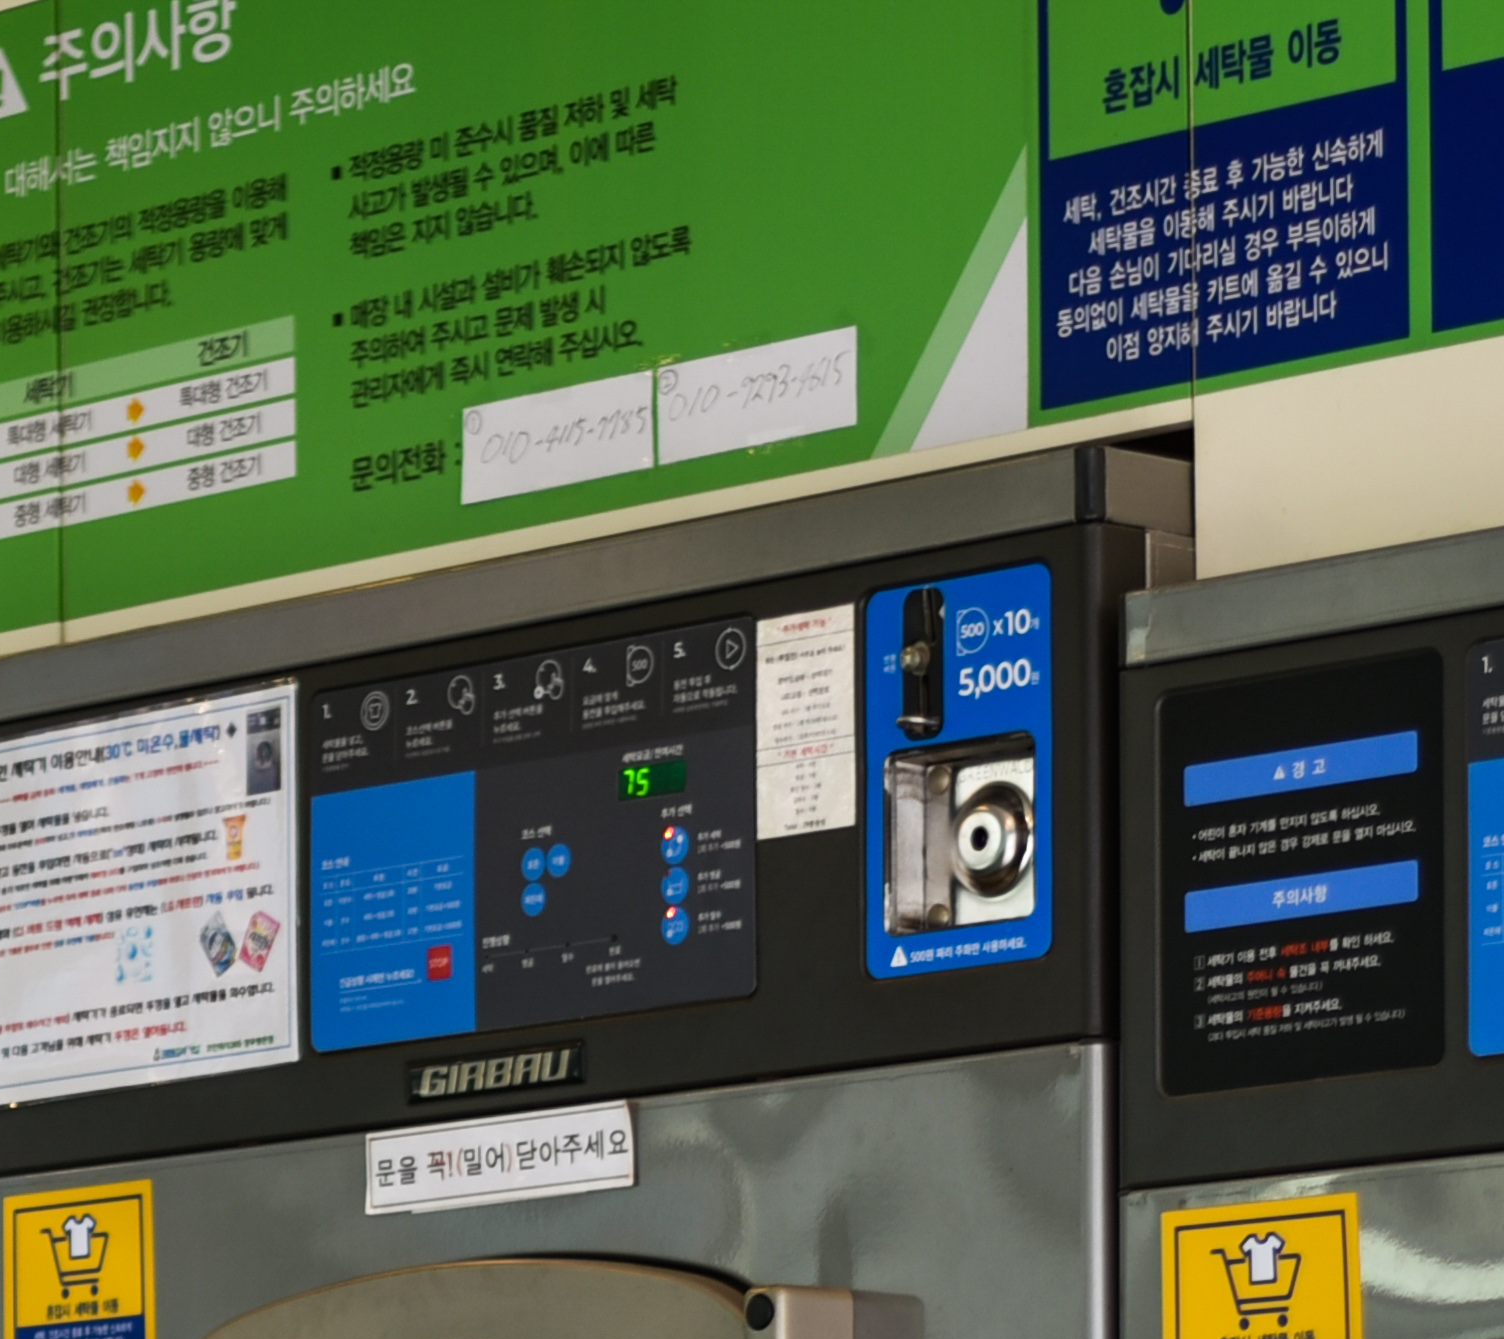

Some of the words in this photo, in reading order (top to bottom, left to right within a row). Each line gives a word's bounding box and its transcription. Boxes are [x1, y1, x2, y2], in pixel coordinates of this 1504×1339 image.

[39, 0, 237, 101] 주의사항
[1102, 49, 1182, 115] 혼잡시
[1193, 33, 1275, 90] 세탁물
[1287, 18, 1342, 69] 이동
[4, 147, 98, 198] 대해서는
[104, 116, 201, 172] 책임지지
[207, 95, 281, 148] 않으니
[288, 62, 417, 126] 주의하세요
[1063, 192, 1102, 225] 세탁,
[1109, 174, 1177, 217] 건조시간
[1183, 165, 1220, 202] 종료
[1225, 158, 1245, 190] 후
[1251, 145, 1305, 183] 가능한
[1311, 127, 1384, 172] 신속하게
[1088, 216, 1156, 256] 세탁물을
[1163, 202, 1215, 240] 이동해
[1221, 190, 1275, 228] 주시기
[1282, 173, 1354, 214] 바랍니다
[1056, 297, 1124, 338] 동의없이
[1130, 278, 1200, 321] 세탁물을
[1207, 268, 1259, 305] 카트에
[1265, 259, 1302, 295] 옮길
[1308, 255, 1328, 285] 수
[1335, 243, 1389, 280] 있으니
[1068, 265, 1103, 296] 다음
[1108, 252, 1160, 290] 손님이
[1167, 235, 1236, 276] 기다리실
[1244, 227, 1280, 262] 경우
[1286, 205, 1376, 252] 부득이하게
[1106, 330, 1140, 363] 이점
[1146, 314, 1200, 356] 양지해
[1205, 305, 1258, 343] 주시기
[1265, 290, 1338, 330] 바랍니다
[350, 439, 447, 493] 문의전화
[960, 621, 986, 640] 500
[417, 1047, 572, 1099] GIRBAU
[373, 1153, 419, 1190] 문을
